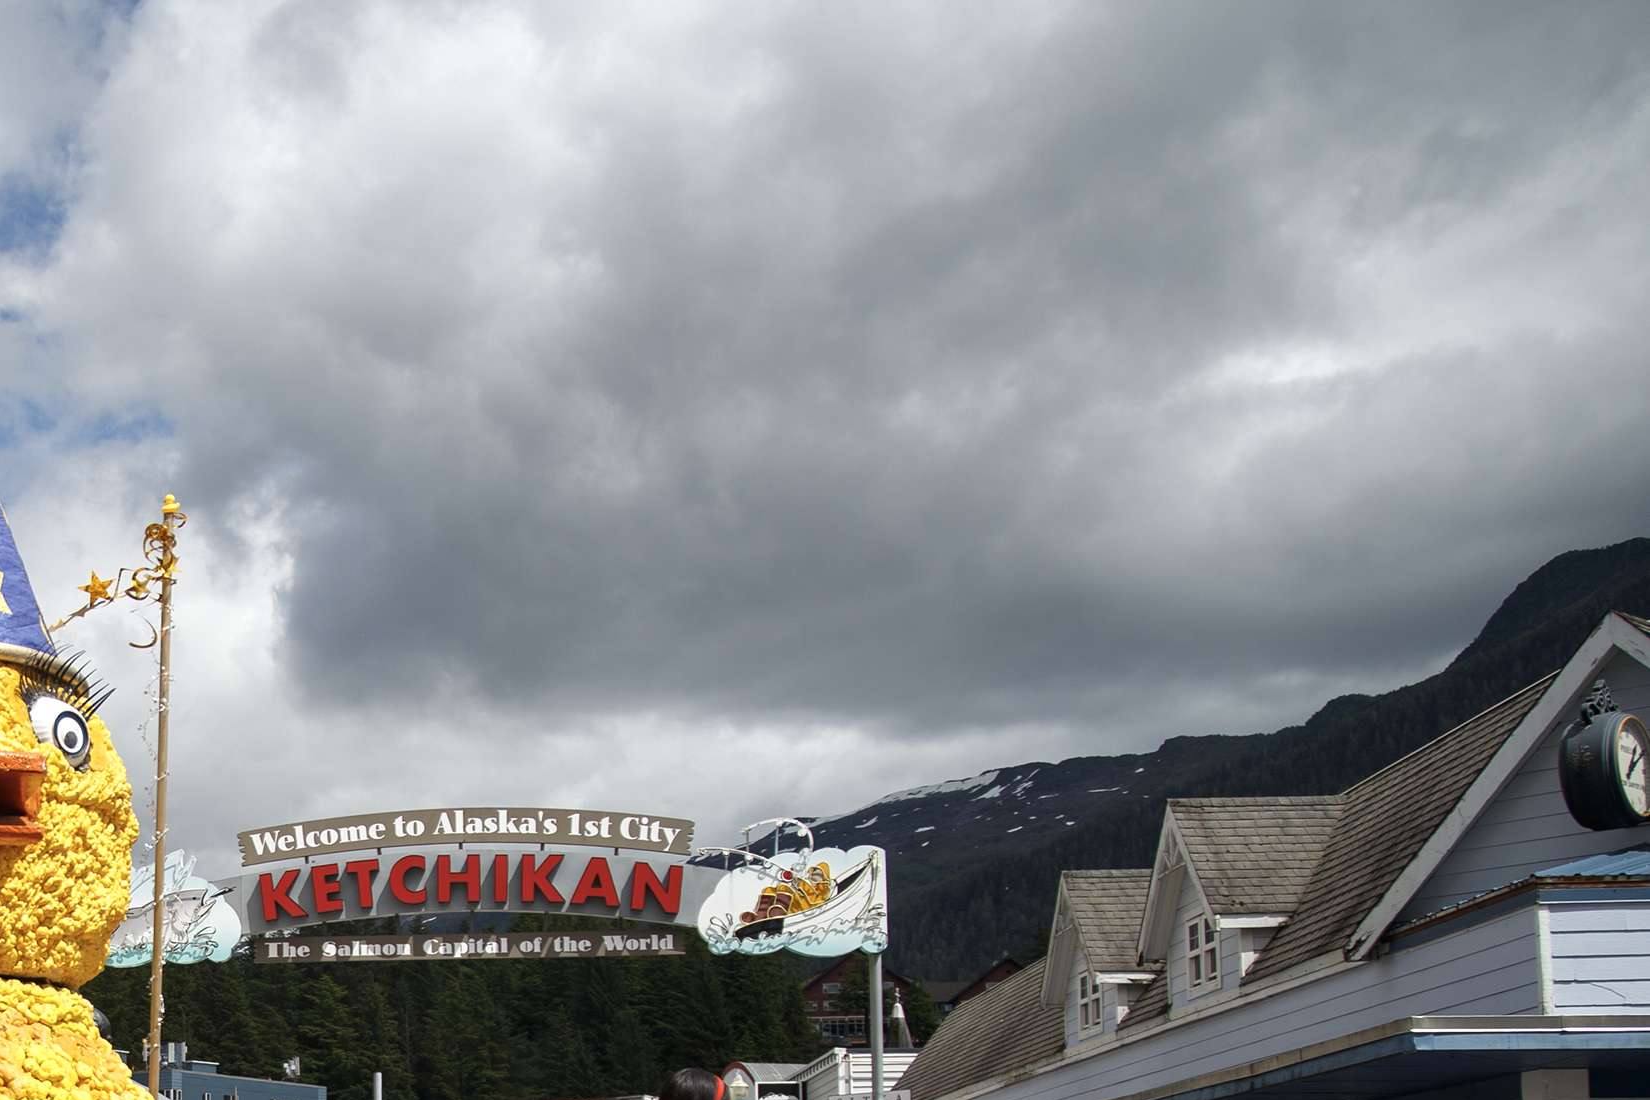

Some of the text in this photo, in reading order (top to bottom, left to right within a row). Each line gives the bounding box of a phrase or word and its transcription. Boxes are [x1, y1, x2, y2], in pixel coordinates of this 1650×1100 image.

[249, 810, 681, 856] Welcome to Alaska's 1st City
[258, 853, 684, 922] KETCHIKAN
[265, 934, 675, 958] The Salmon Capital of the World
